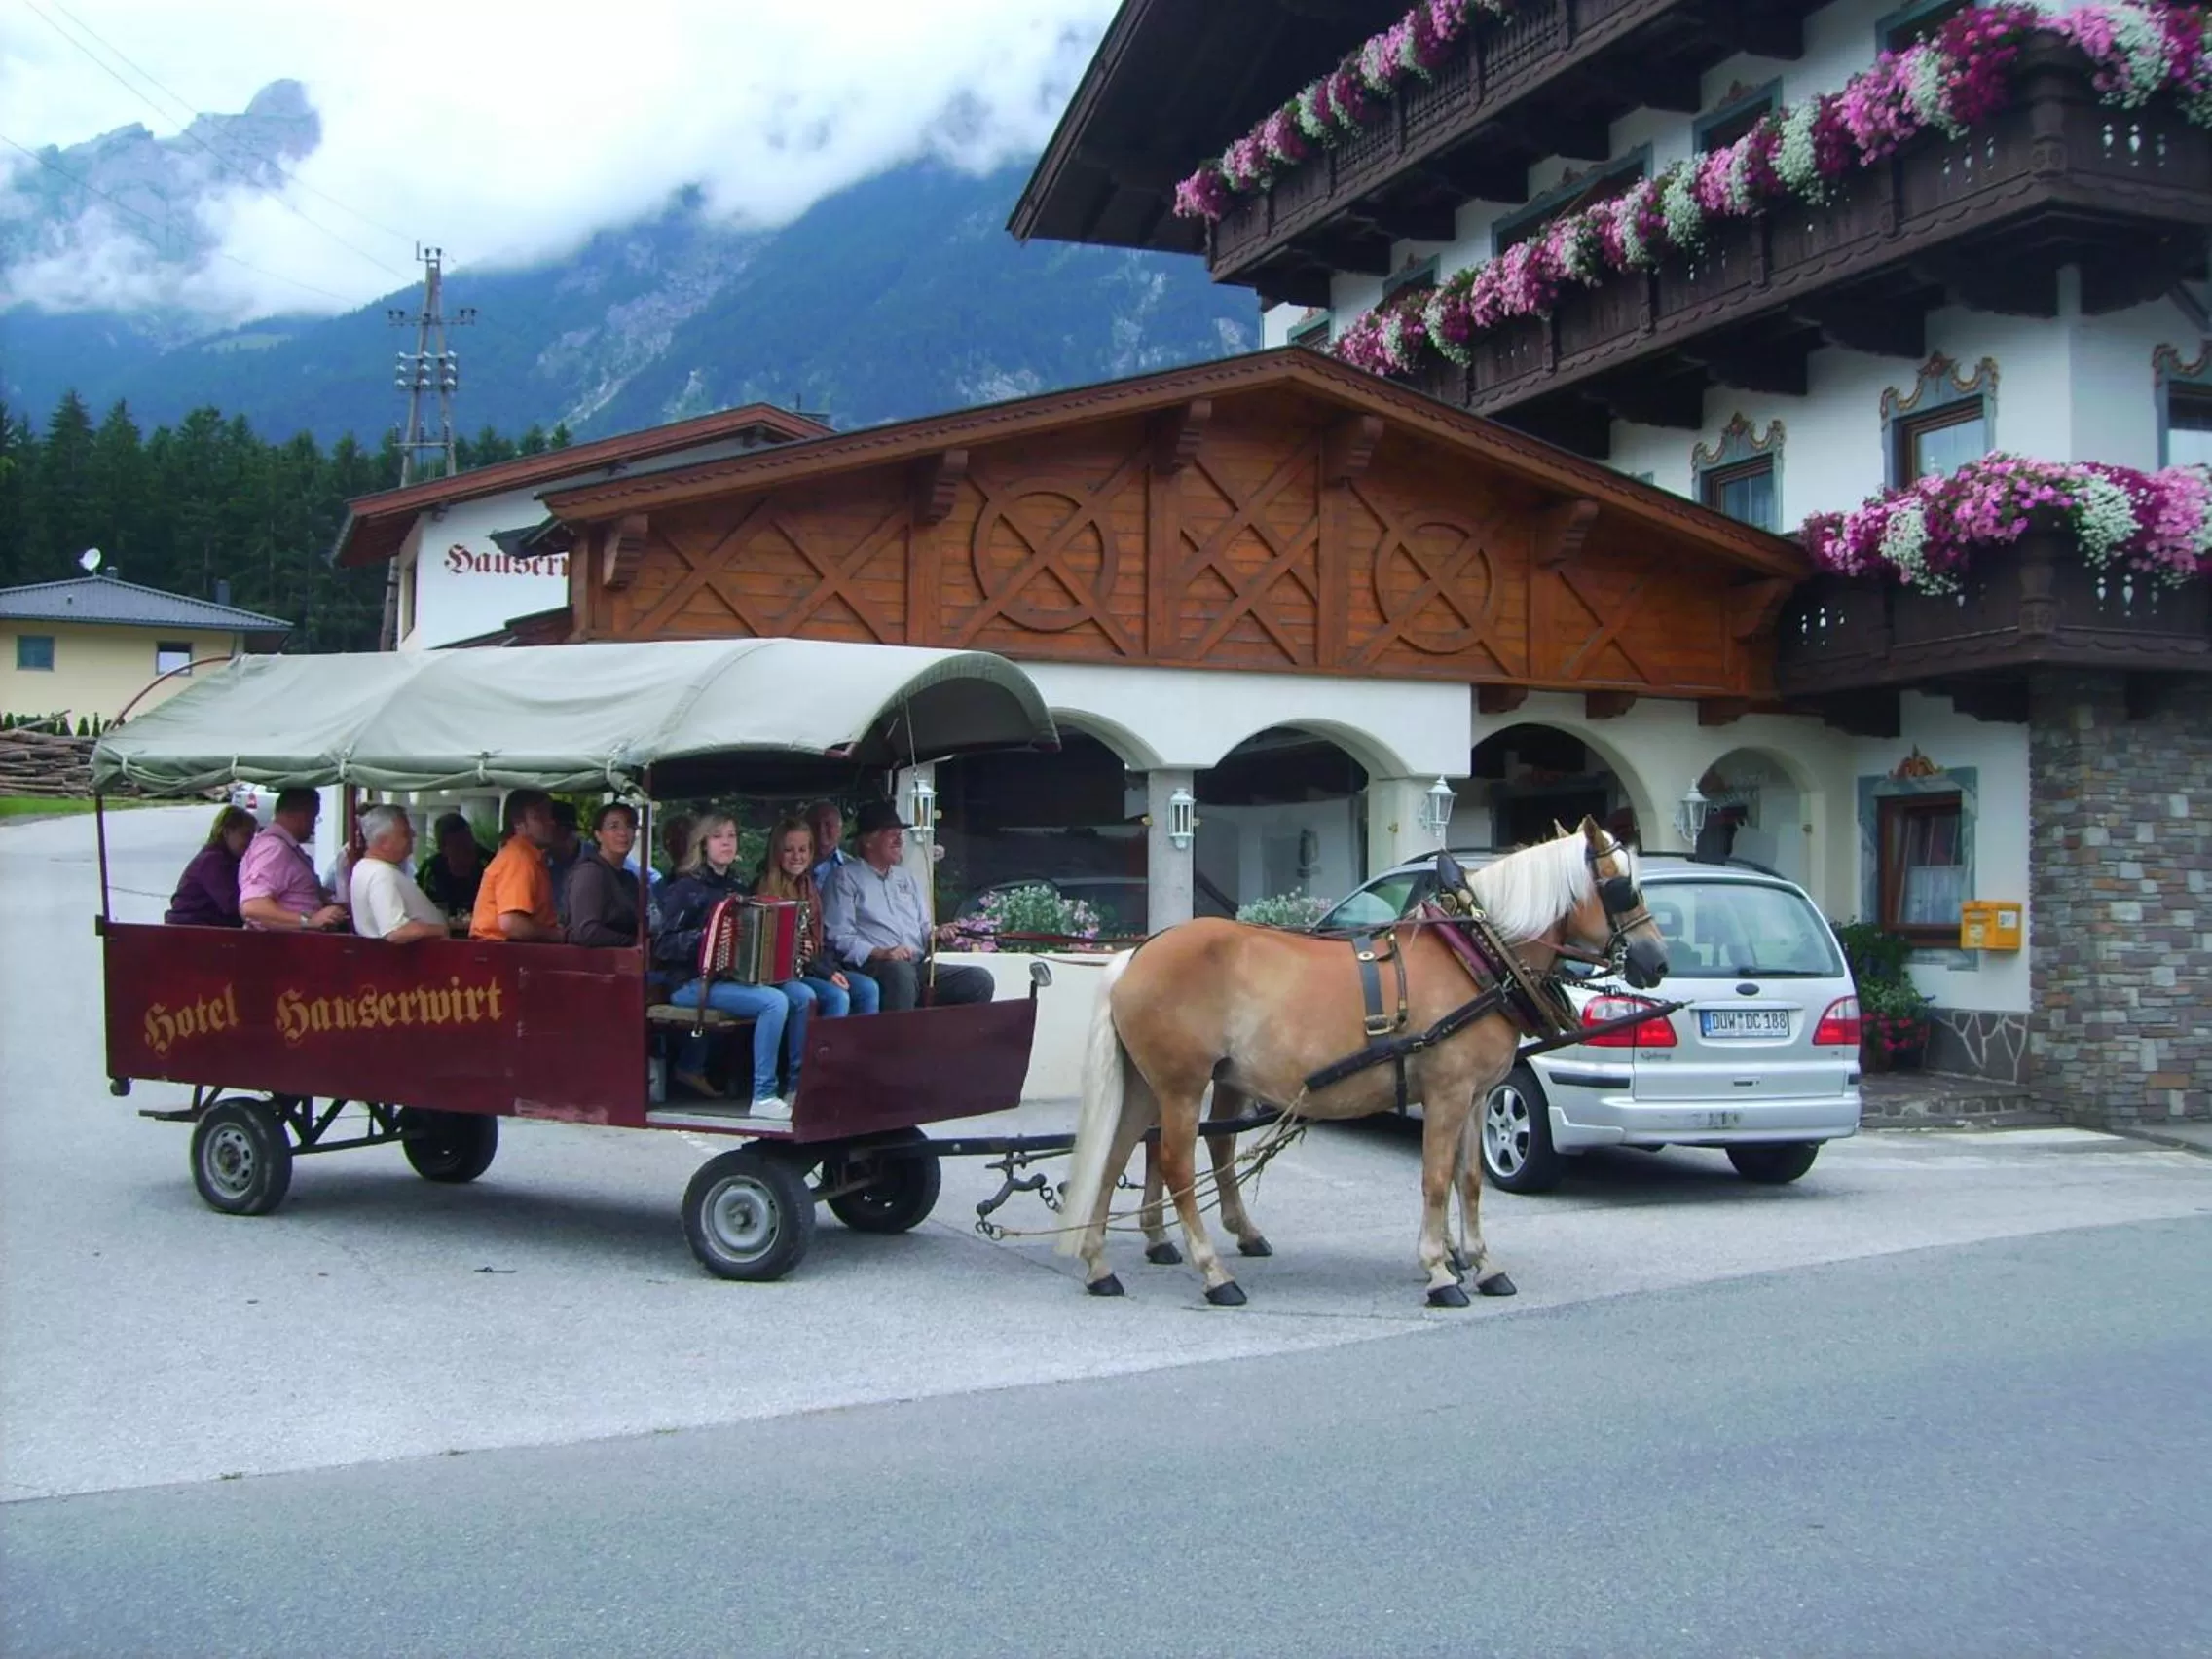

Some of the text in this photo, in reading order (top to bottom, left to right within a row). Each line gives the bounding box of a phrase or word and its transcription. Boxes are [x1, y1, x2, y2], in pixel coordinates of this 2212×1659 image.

[144, 975, 504, 1060] Hotel Hauserwirt
[1764, 1012, 1787, 1029] 188
